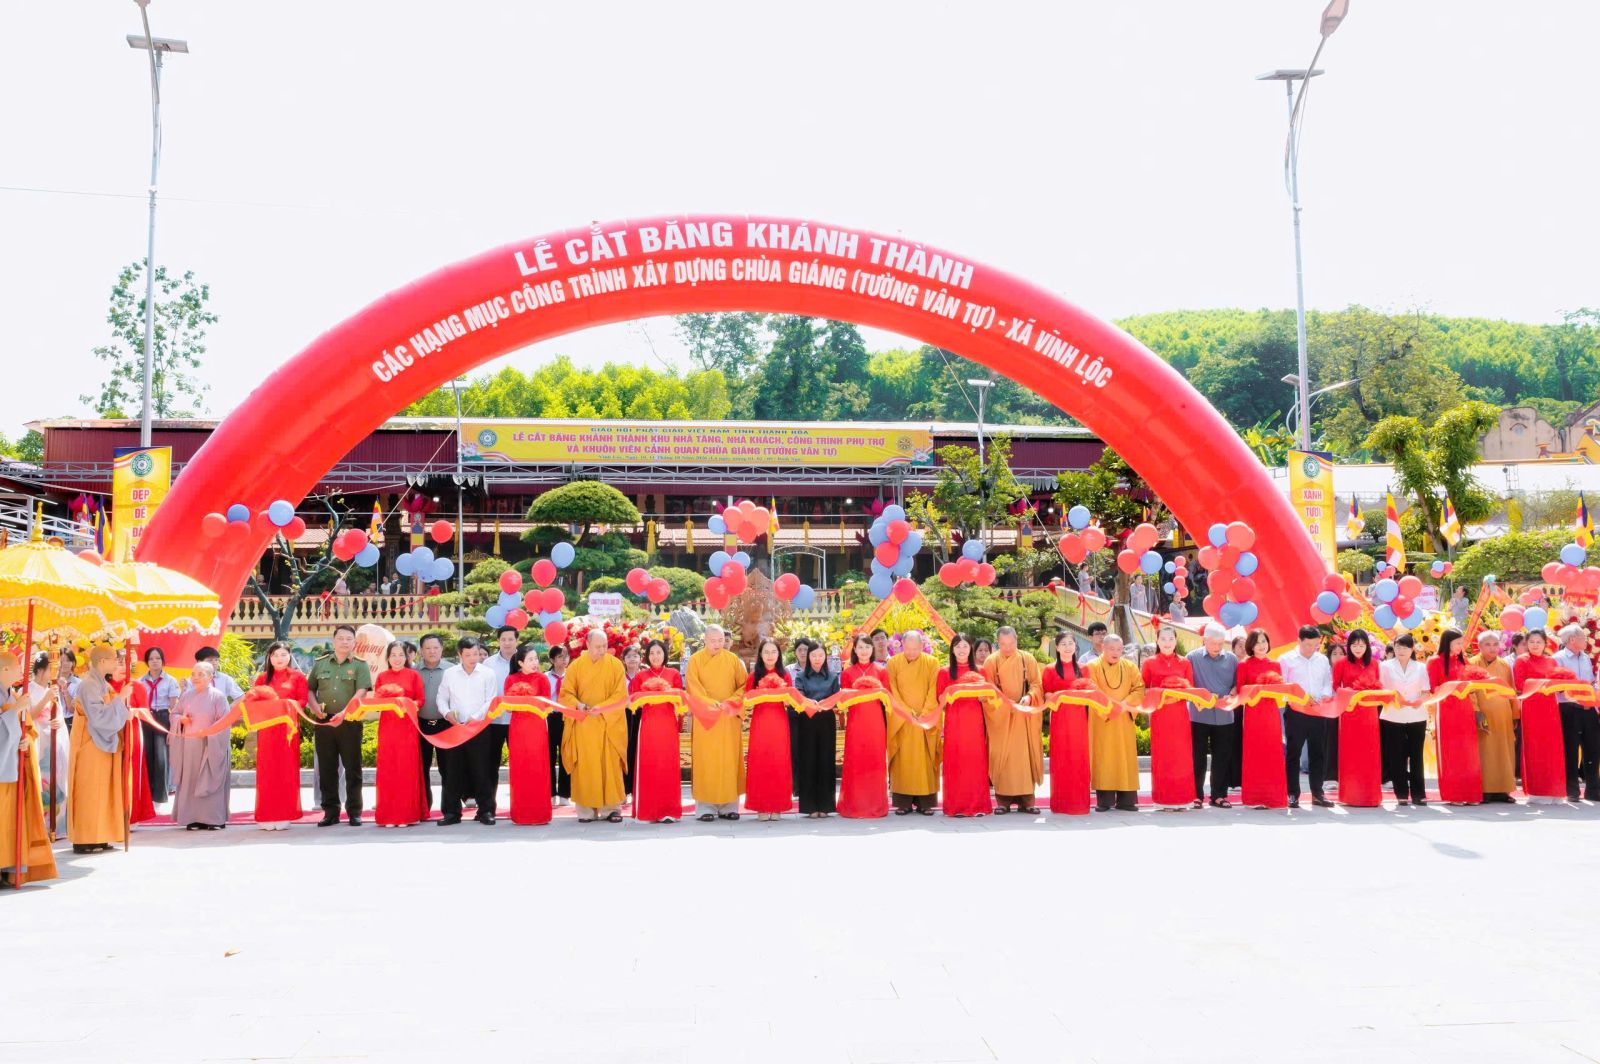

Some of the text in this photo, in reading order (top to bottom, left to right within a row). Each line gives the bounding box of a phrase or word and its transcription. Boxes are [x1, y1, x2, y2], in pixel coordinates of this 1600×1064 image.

[514, 239, 558, 276] LỄ
[639, 219, 733, 253] BĂNG
[746, 222, 859, 259] KHÁNH
[869, 237, 974, 289] THÀNH
[371, 349, 415, 383] CÁC
[409, 314, 467, 358] HẠNG
[463, 296, 510, 332] MỤC
[510, 283, 566, 314] CÔNG
[567, 267, 627, 299] TRÌNH
[632, 259, 668, 289] XÂY
[674, 257, 727, 287] DỰNG
[731, 254, 782, 282] CHÙA
[788, 258, 847, 290] GIÁNG
[850, 269, 919, 308] (TƯỜNG
[921, 288, 961, 320] VÂN
[962, 301, 996, 333] TỰ)
[1004, 317, 1037, 347] XÃ
[1033, 329, 1080, 369] VĨNH
[1074, 355, 1113, 389] LỘC
[579, 432, 613, 443] KHÁNH
[616, 433, 648, 443] THÀNH
[650, 434, 670, 443] KHU
[673, 433, 694, 443] NHÀ
[727, 435, 747, 443] NHÀ
[787, 436, 813, 445] CÔNG
[816, 436, 843, 445] TRÌNH
[566, 444, 579, 453] VÀ
[582, 444, 616, 454] KHUÔN
[619, 445, 641, 454] VIÊN
[673, 445, 700, 455] QUAN
[702, 445, 728, 455] CHÙA
[731, 446, 761, 456] GIÁNG
[801, 446, 820, 455] VÂN
[1303, 489, 1322, 500] XANH
